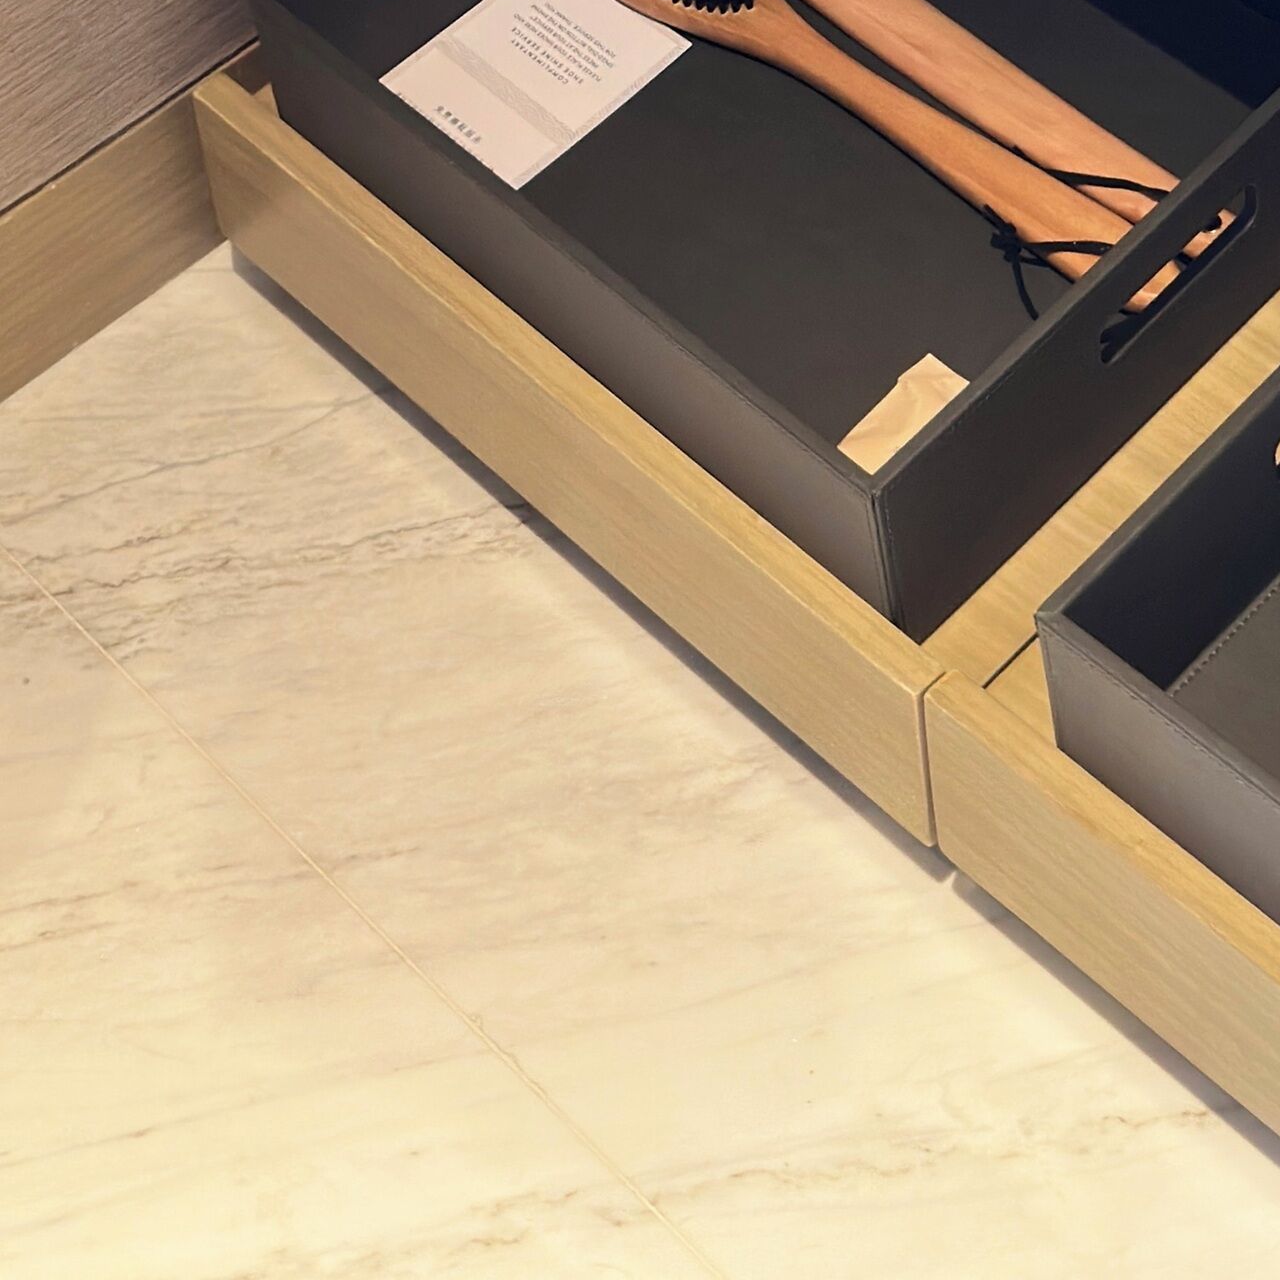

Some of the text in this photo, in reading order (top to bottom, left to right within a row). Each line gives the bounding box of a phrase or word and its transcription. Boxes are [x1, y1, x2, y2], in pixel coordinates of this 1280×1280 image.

[509, 37, 569, 84] COMPLIMENTARY
[510, 26, 584, 84] SHOE SHINE SERVICE
